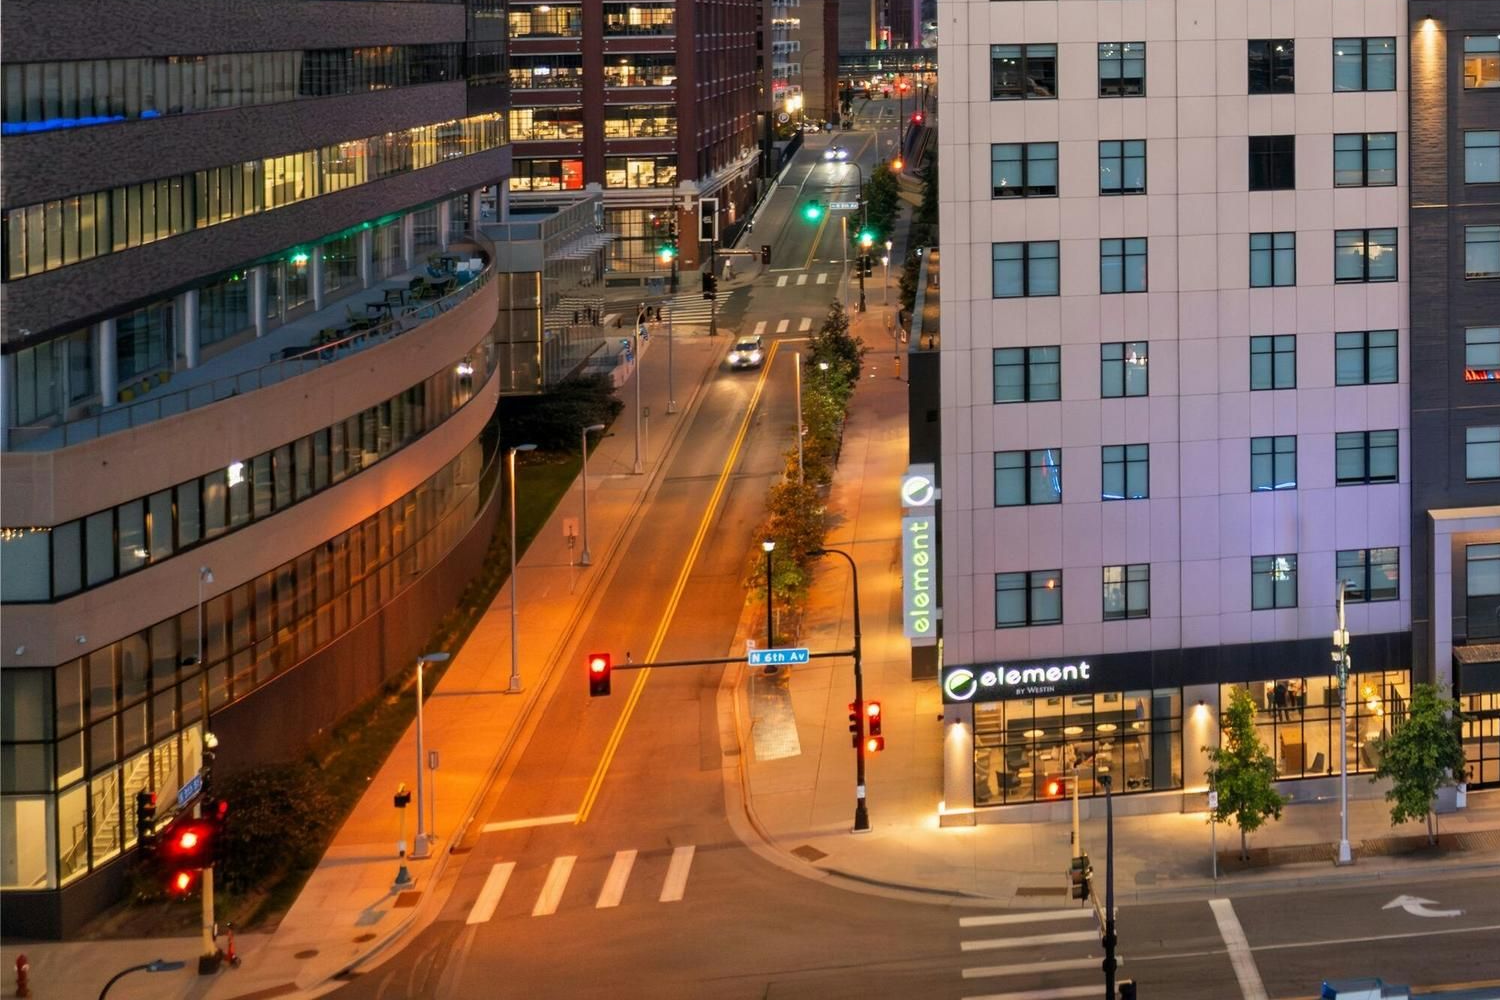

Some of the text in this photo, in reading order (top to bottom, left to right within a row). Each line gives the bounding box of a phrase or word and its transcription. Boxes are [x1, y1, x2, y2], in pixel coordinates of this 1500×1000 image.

[909, 520, 930, 633] element
[751, 651, 805, 663] N 6th Av
[979, 660, 1090, 687] element
